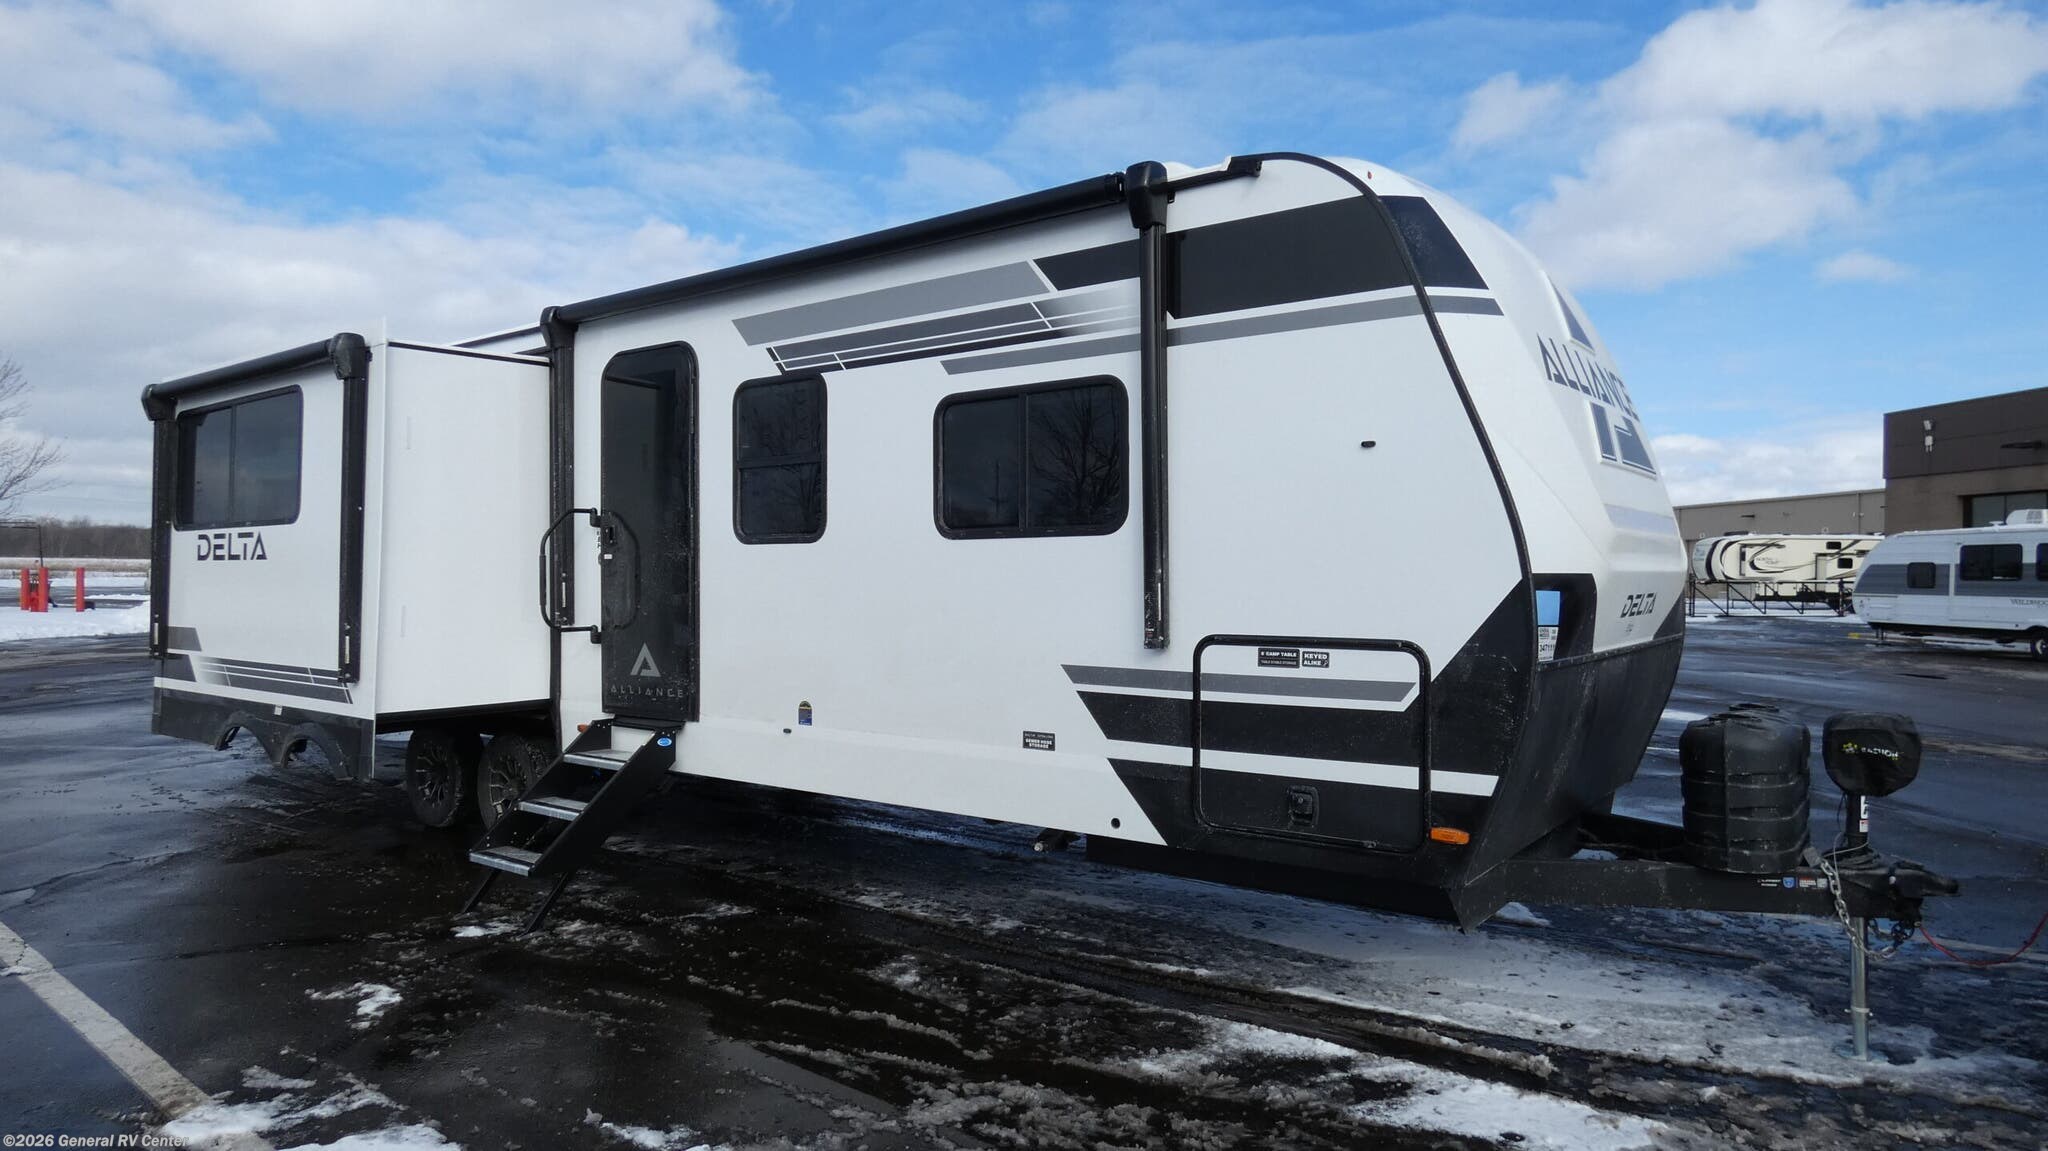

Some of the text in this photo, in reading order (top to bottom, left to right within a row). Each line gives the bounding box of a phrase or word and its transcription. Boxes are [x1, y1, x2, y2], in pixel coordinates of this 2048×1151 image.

[1537, 332, 1640, 422] ALLIANCE
[197, 531, 268, 561] DELTA
[1620, 592, 1657, 618] DELTA
[610, 684, 684, 698] ALLIANCE
